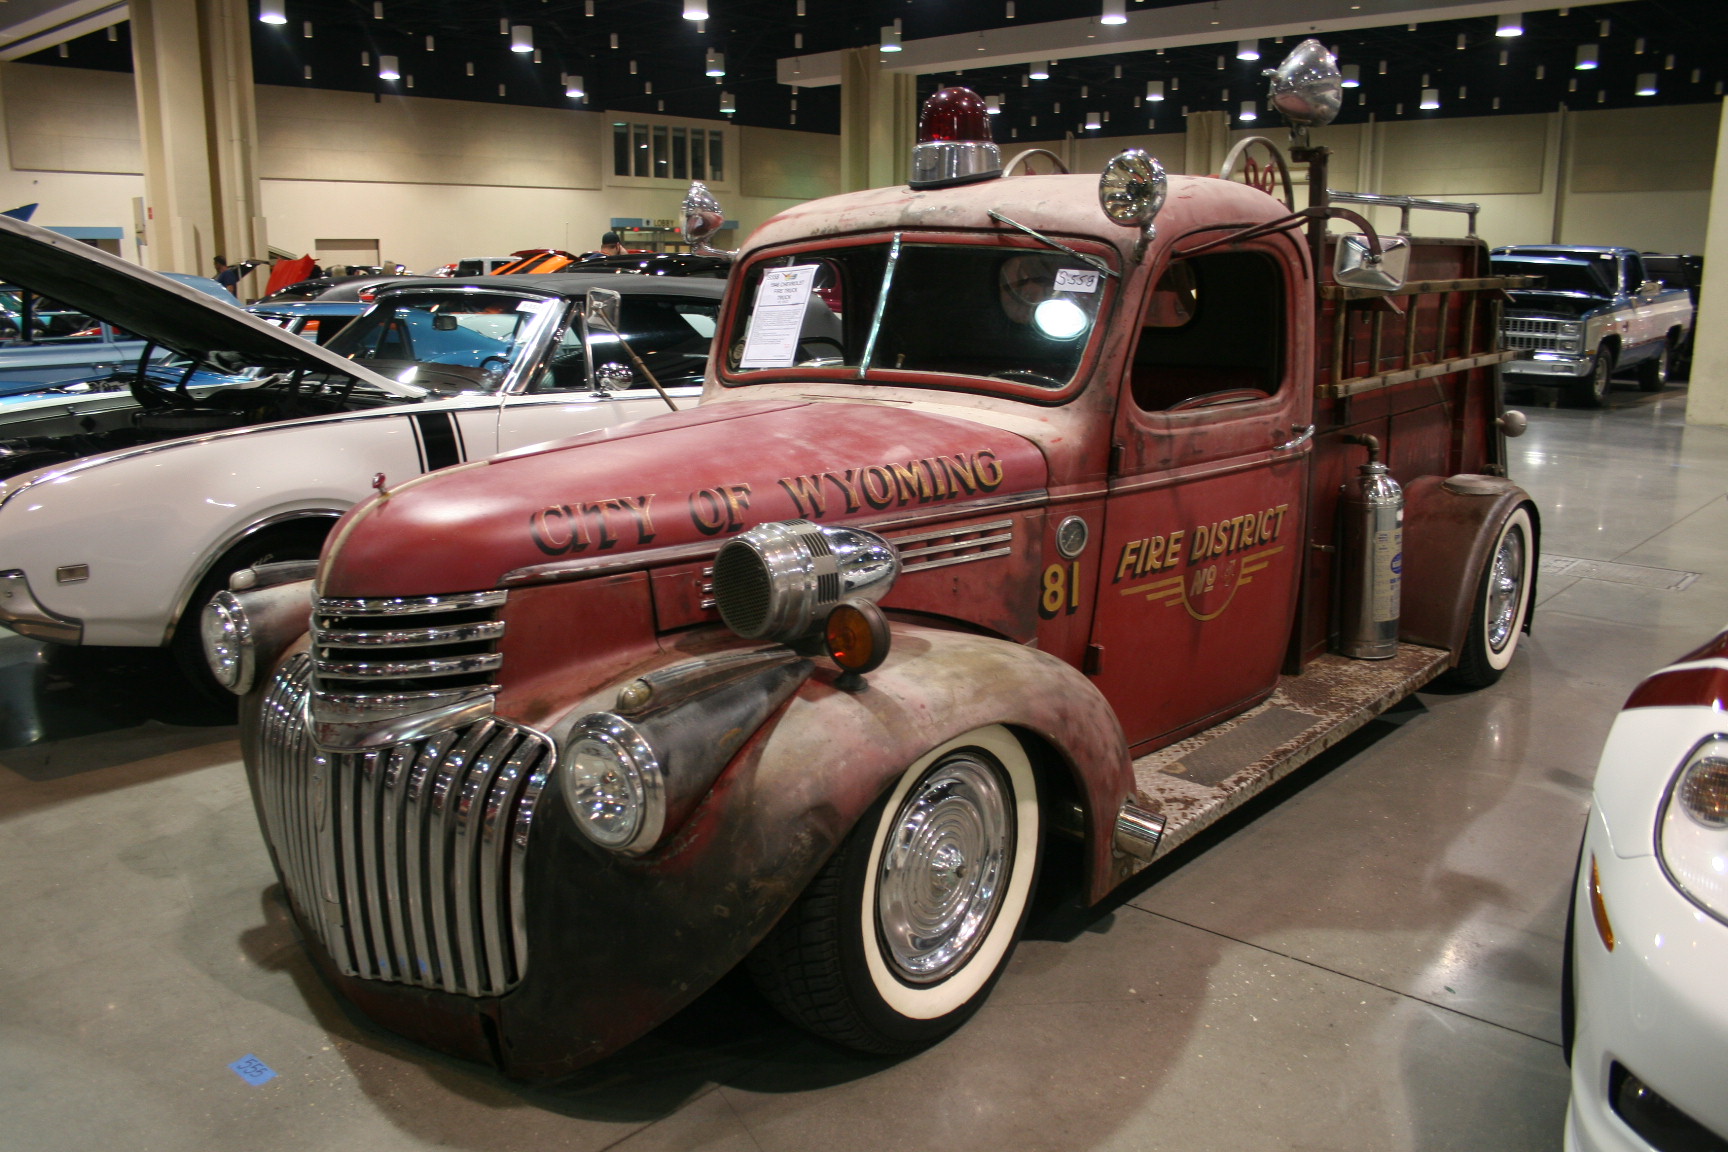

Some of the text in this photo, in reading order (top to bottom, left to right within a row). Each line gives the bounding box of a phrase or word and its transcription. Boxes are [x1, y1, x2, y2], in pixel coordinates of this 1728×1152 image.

[529, 448, 1003, 556] CITY OF WYOMING
[1113, 530, 1185, 583] FIRE
[1188, 503, 1289, 565] DISTRICT
[1039, 561, 1080, 618] 81
